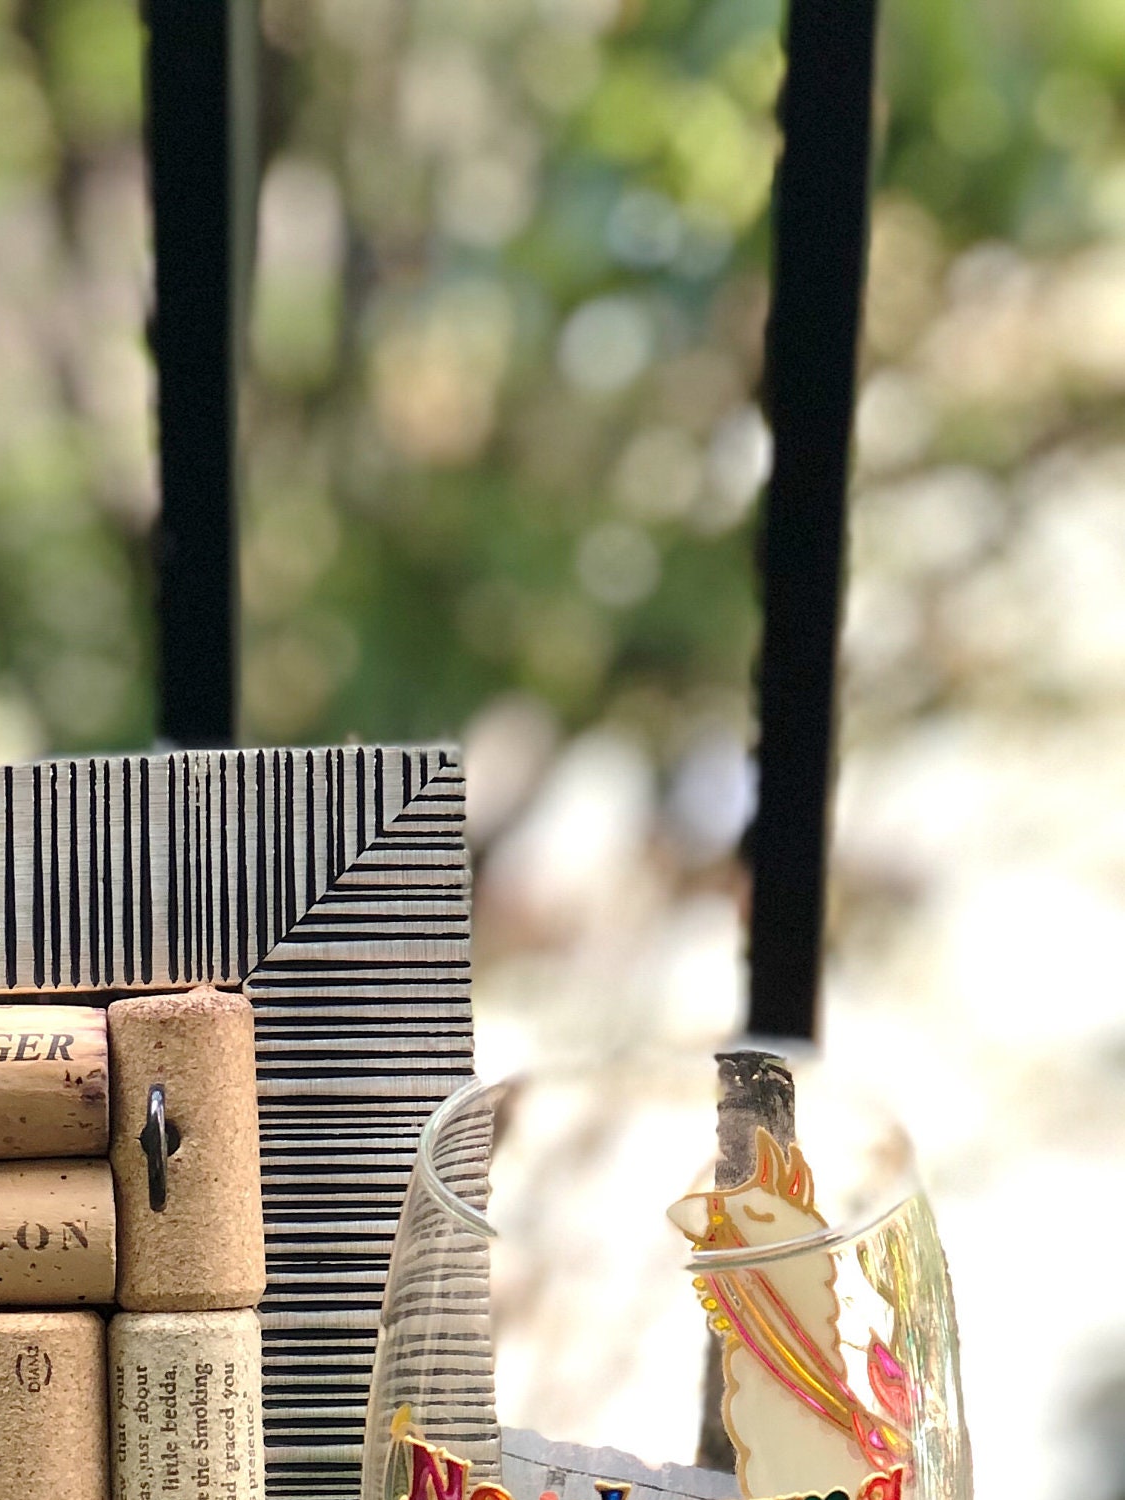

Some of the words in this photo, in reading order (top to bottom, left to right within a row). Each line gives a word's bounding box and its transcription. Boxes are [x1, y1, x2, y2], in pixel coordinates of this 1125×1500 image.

[115, 1365, 129, 1410] your
[136, 1365, 153, 1424] about
[222, 1362, 240, 1401] you
[188, 1362, 214, 1451] Smoking
[116, 1423, 129, 1463] that
[218, 1406, 242, 1474] graced
[160, 1441, 180, 1491] little
[191, 1459, 210, 1488] the
